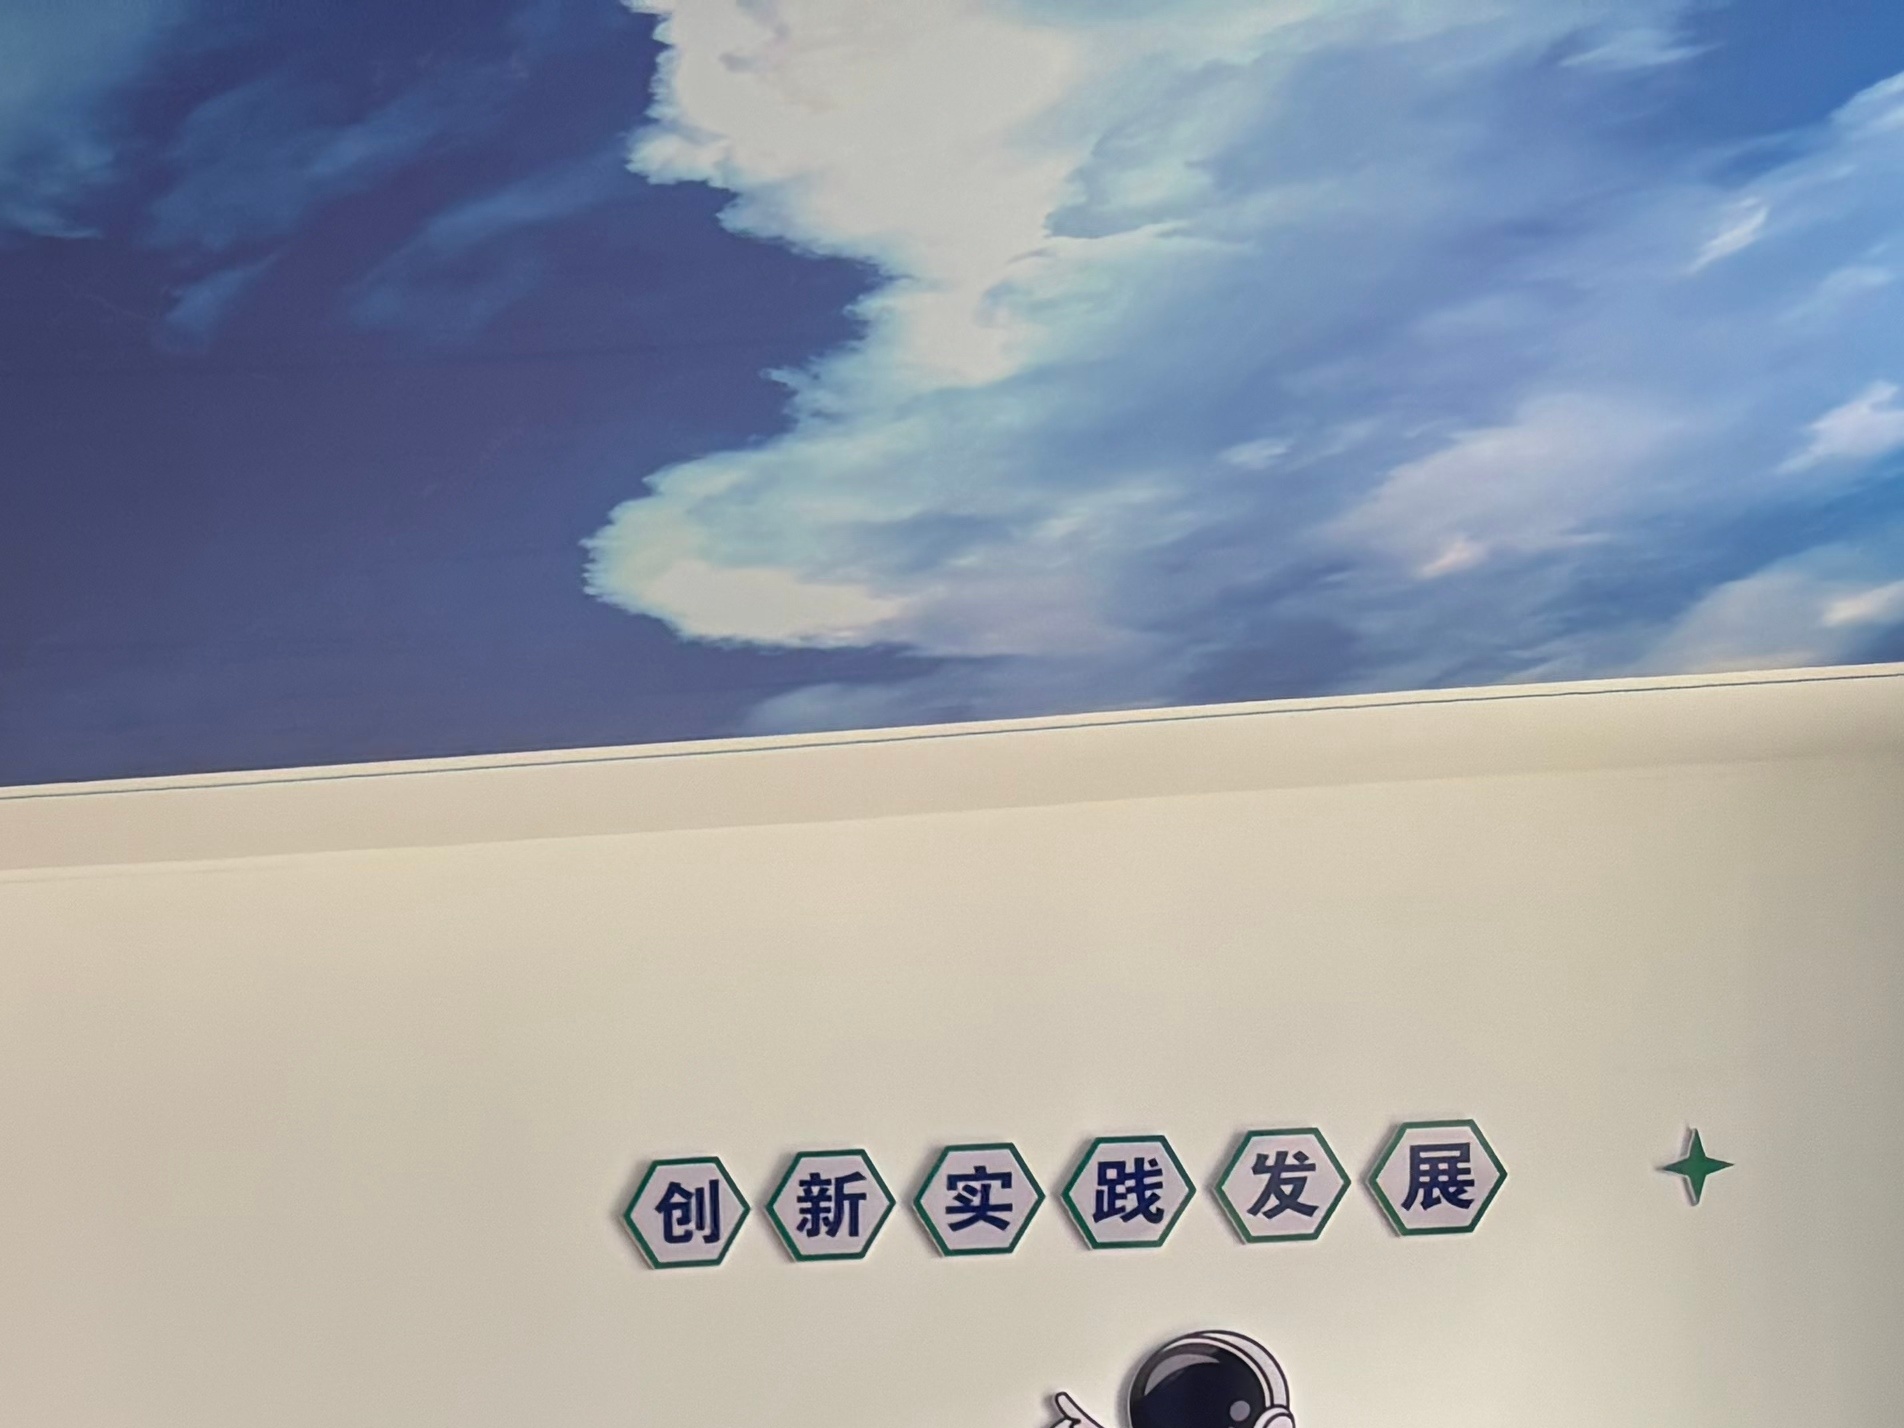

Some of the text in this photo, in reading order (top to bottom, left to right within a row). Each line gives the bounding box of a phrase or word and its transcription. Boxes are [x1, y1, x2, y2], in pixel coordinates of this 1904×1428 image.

[655, 1144, 1476, 1245] 创新实践发展
